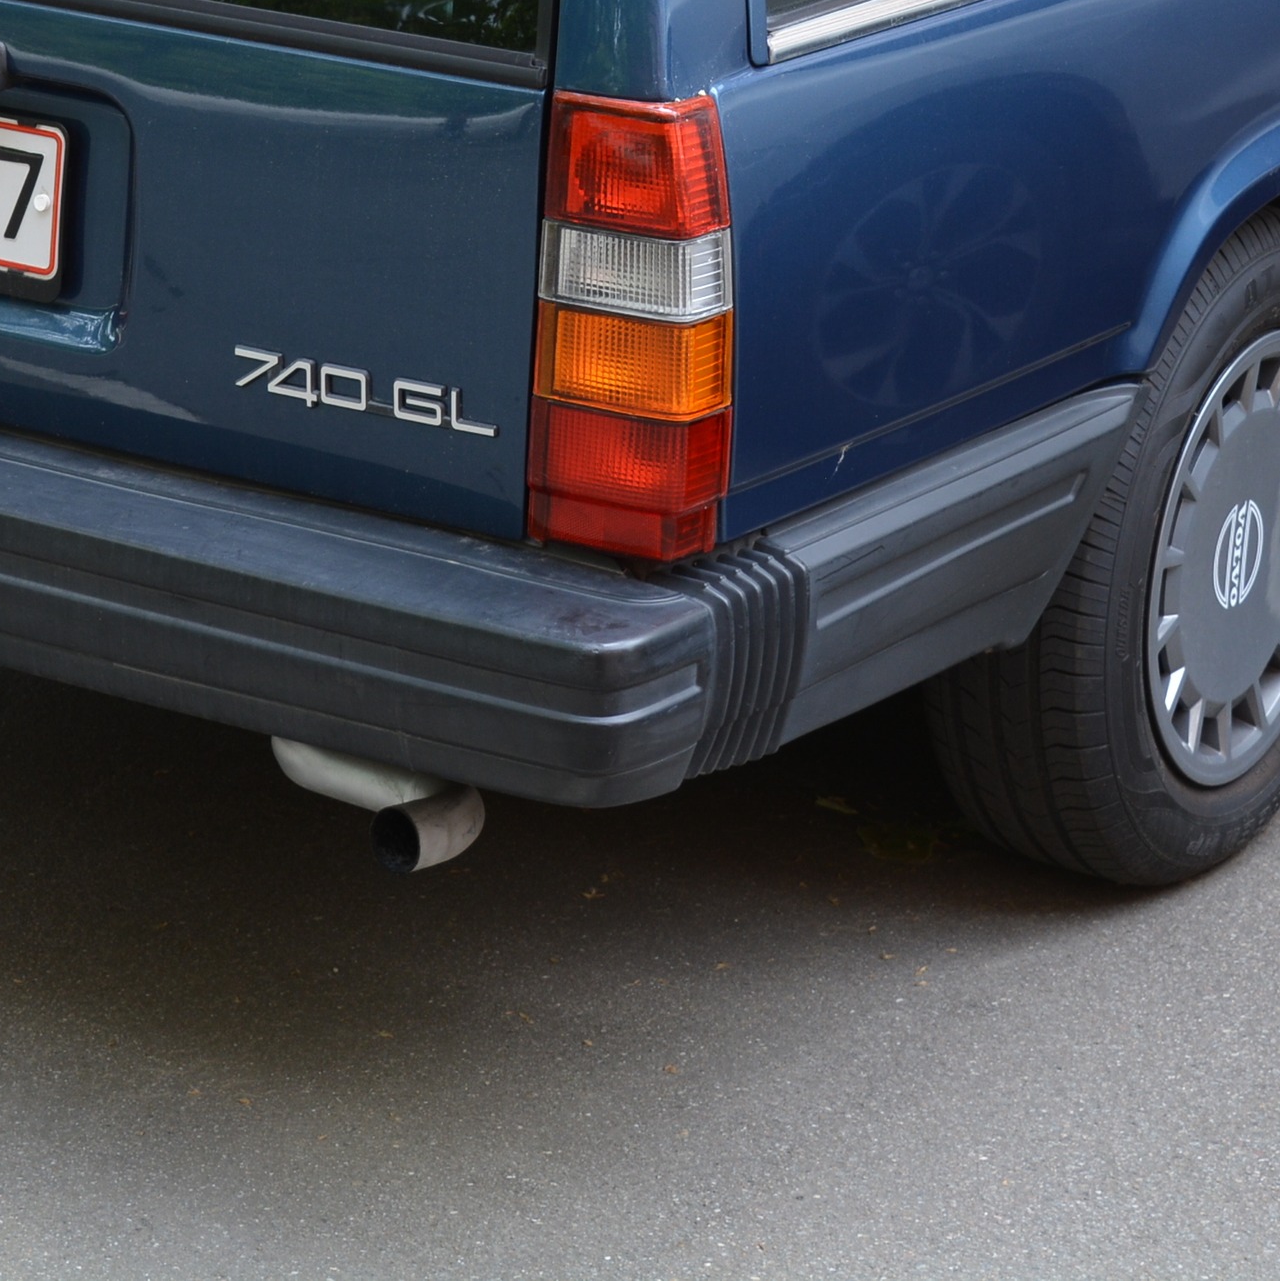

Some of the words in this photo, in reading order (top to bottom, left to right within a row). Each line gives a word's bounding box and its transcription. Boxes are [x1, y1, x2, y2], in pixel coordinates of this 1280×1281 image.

[234, 344, 369, 408] 740
[393, 377, 499, 438] GL
[1229, 499, 1248, 608] VOLVO
